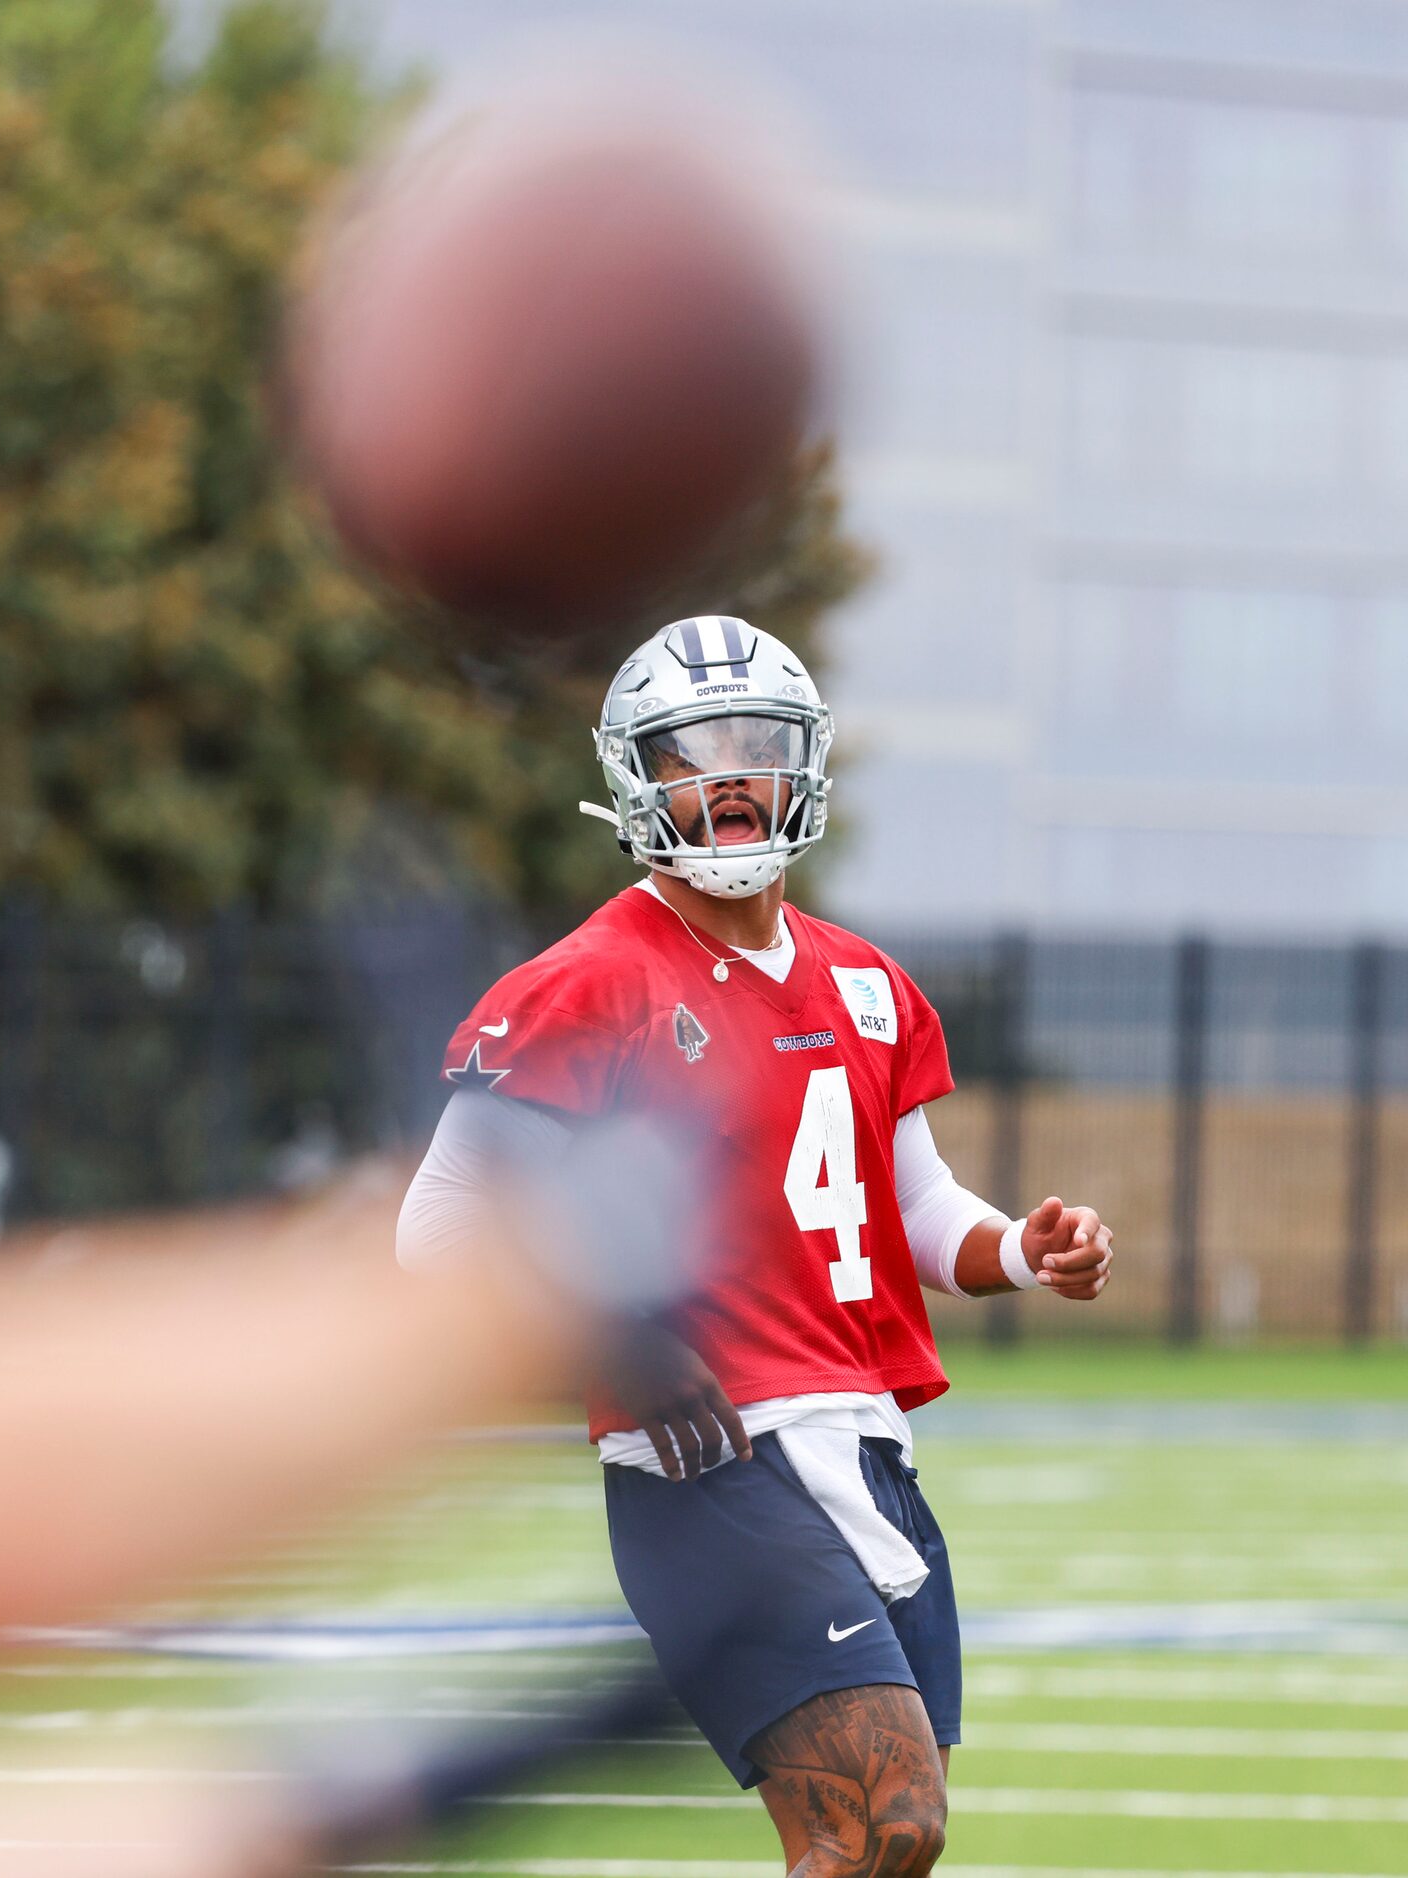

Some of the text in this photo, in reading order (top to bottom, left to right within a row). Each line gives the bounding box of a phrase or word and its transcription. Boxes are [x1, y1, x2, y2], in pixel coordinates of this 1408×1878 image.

[696, 683, 749, 697] COWBOYS
[860, 1013, 888, 1033] AT&T
[773, 1030, 835, 1051] COWBOYS
[783, 1065, 873, 1303] 4
